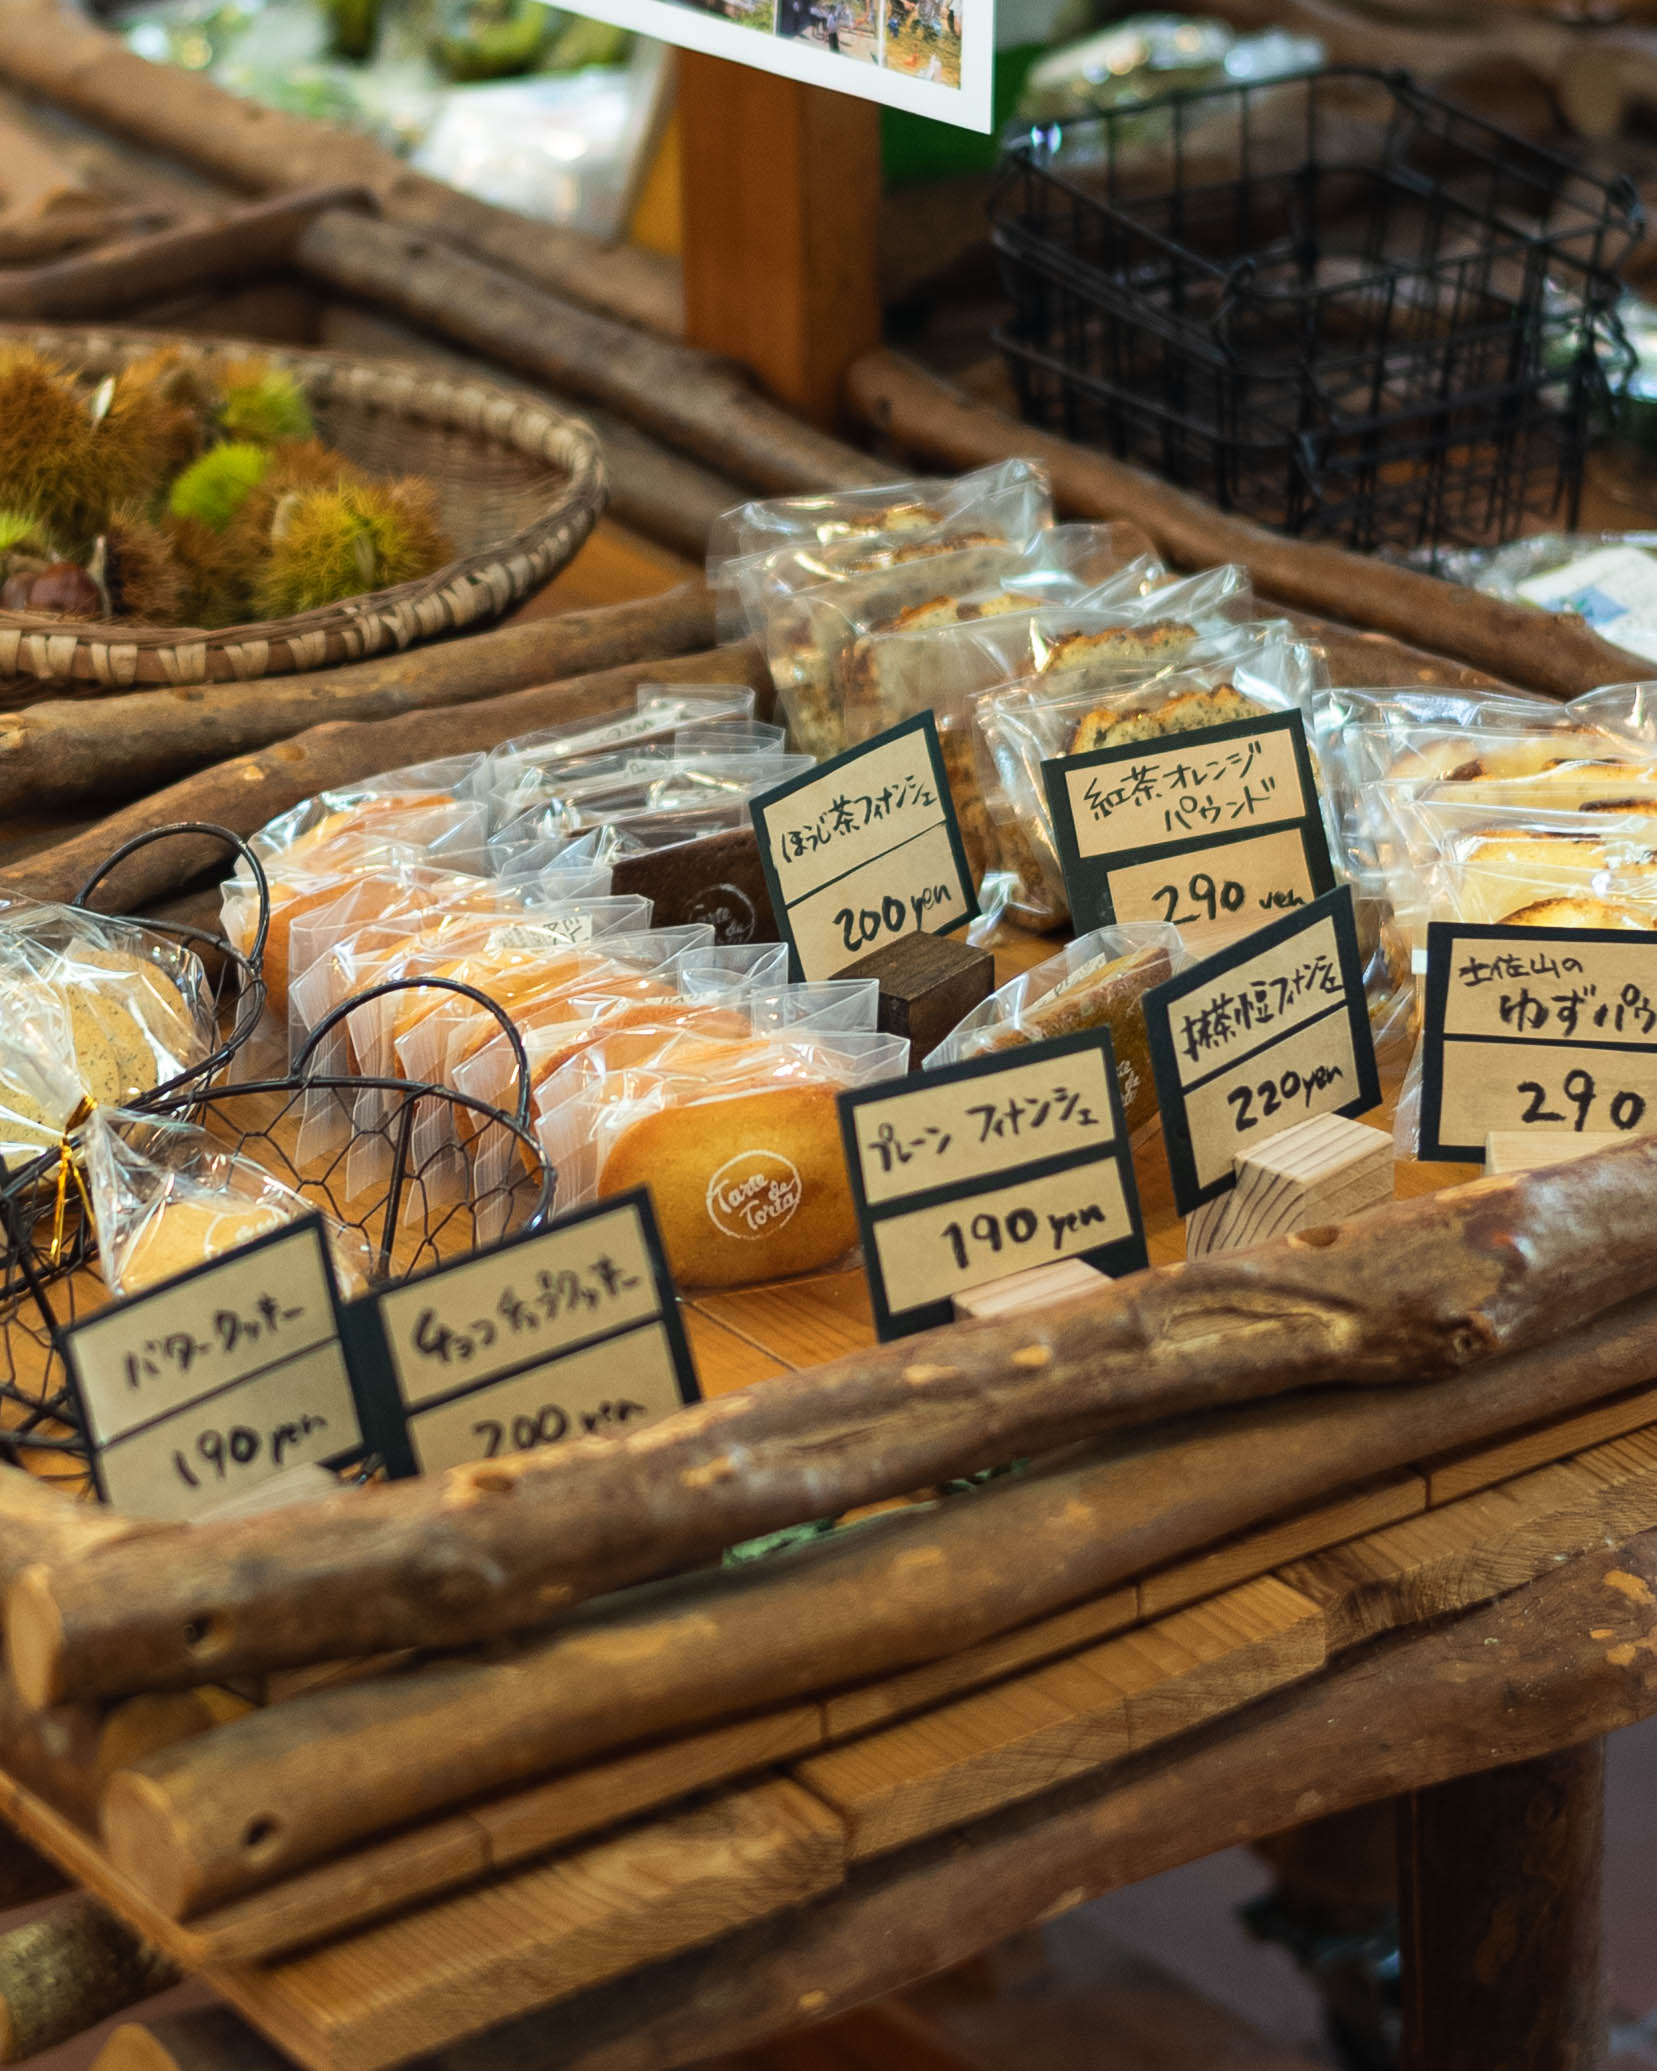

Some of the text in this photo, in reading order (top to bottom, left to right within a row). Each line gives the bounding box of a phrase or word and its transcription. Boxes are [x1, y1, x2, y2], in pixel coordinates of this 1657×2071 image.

[1084, 741, 1262, 820] 紅茶オレンジ
[1164, 777, 1276, 831] パウンド
[1152, 873, 1246, 924] 290
[1458, 953, 1583, 986] 土佐山の
[868, 1086, 1100, 1172] プレーン フィナンシェ
[1517, 1069, 1646, 1132] 290
[738, 1192, 797, 1230] Torta
[940, 1207, 1038, 1270] 190
[172, 1424, 261, 1489] 190
